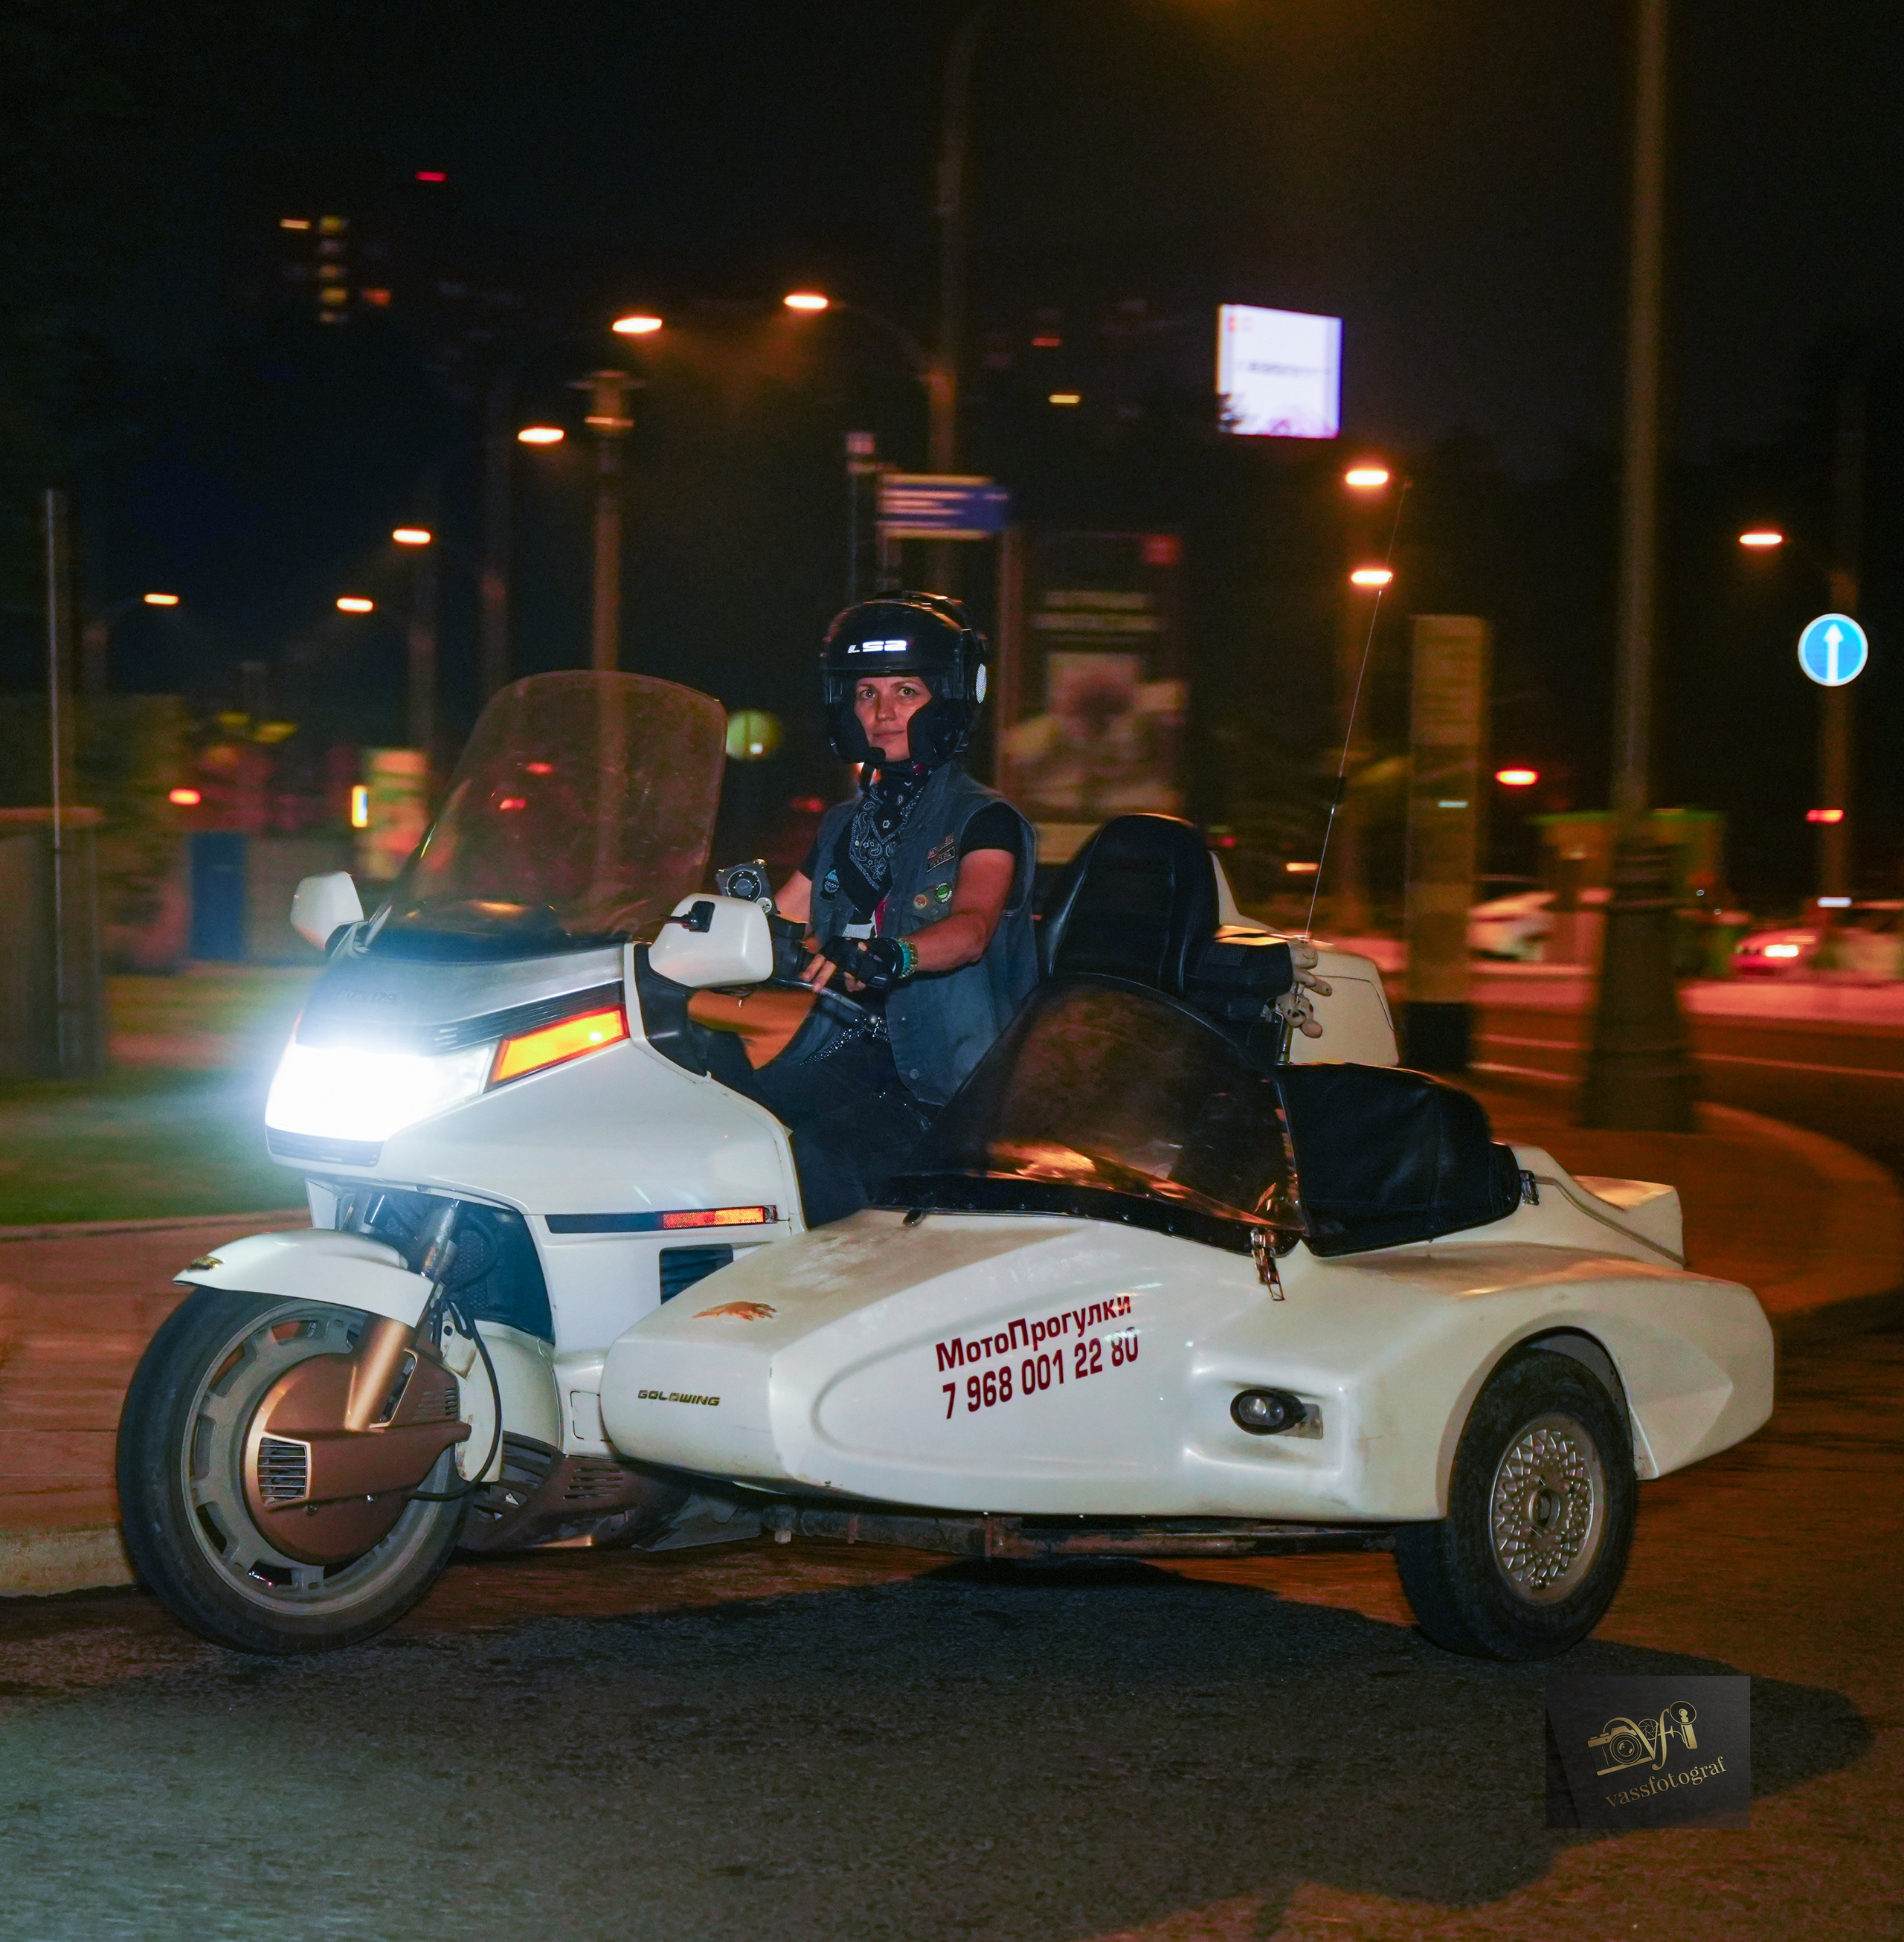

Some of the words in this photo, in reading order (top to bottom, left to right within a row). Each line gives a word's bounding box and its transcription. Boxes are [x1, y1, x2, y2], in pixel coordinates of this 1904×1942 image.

[848, 640, 907, 654] LS2
[936, 1296, 1131, 1372] МотоПрогулки
[942, 1382, 956, 1420] 7
[967, 1366, 1012, 1412] 968
[1021, 1348, 1064, 1395] 001
[1074, 1338, 1103, 1379] 22
[1111, 1326, 1139, 1367] 80
[637, 1389, 721, 1406] GOLDWING
